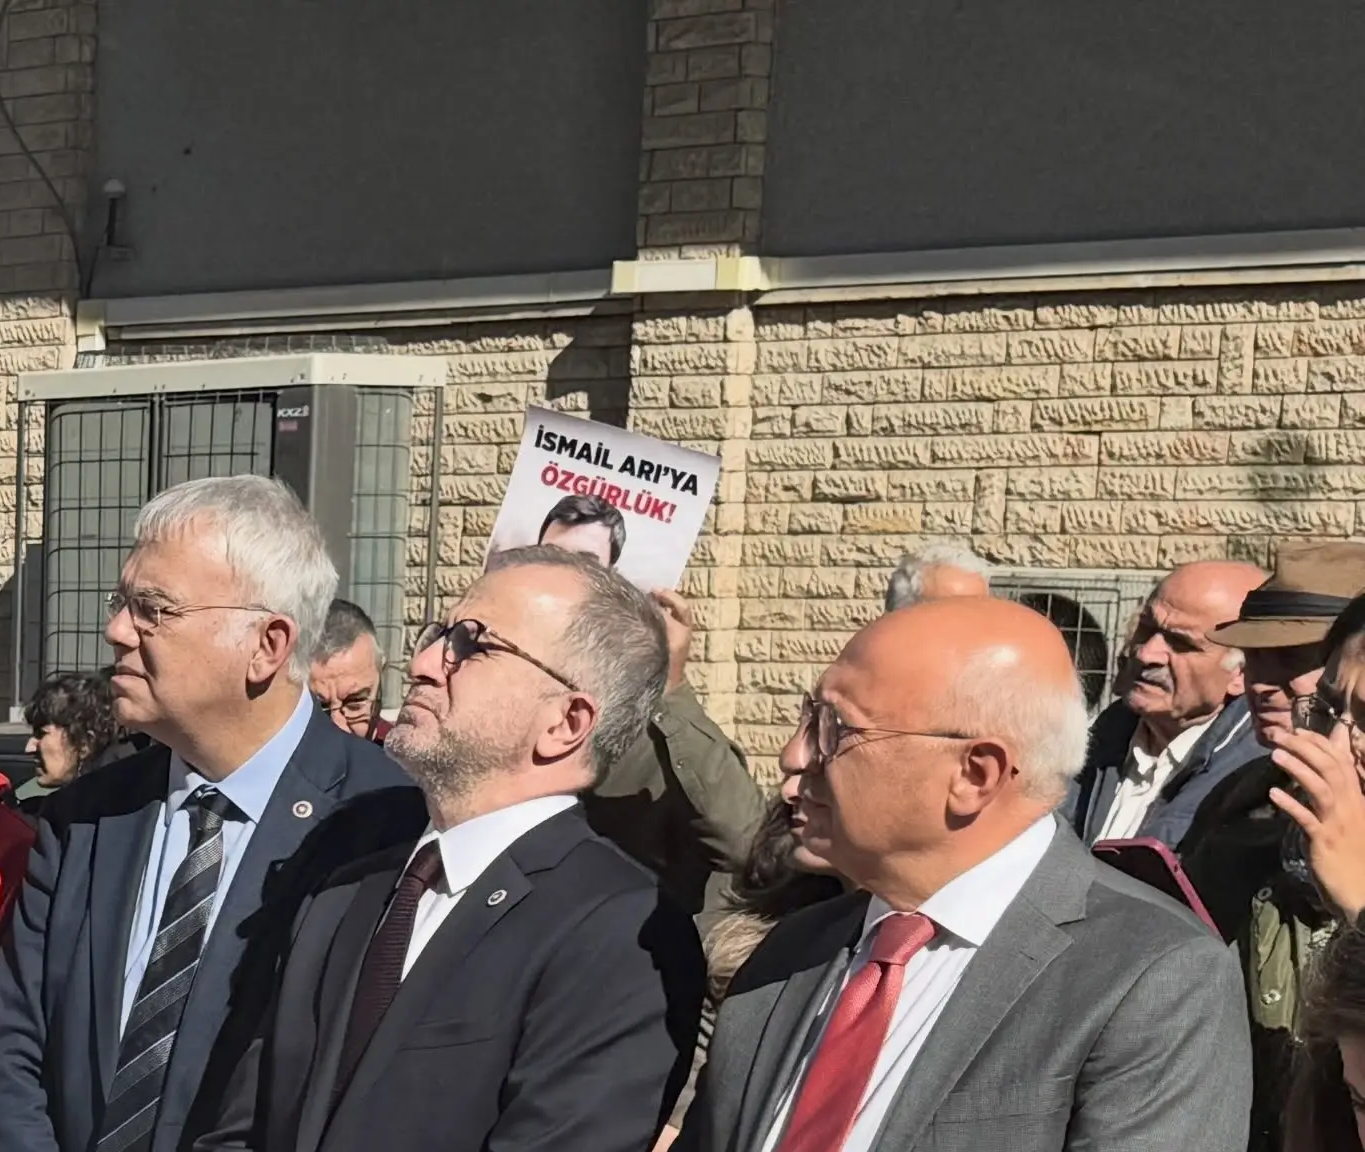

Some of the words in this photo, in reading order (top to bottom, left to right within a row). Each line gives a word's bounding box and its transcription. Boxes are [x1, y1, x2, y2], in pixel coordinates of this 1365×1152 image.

[534, 424, 614, 471] İSMAİL
[618, 455, 699, 497] ARI'YA
[540, 460, 678, 524] ÖZGÜRLÜK!
